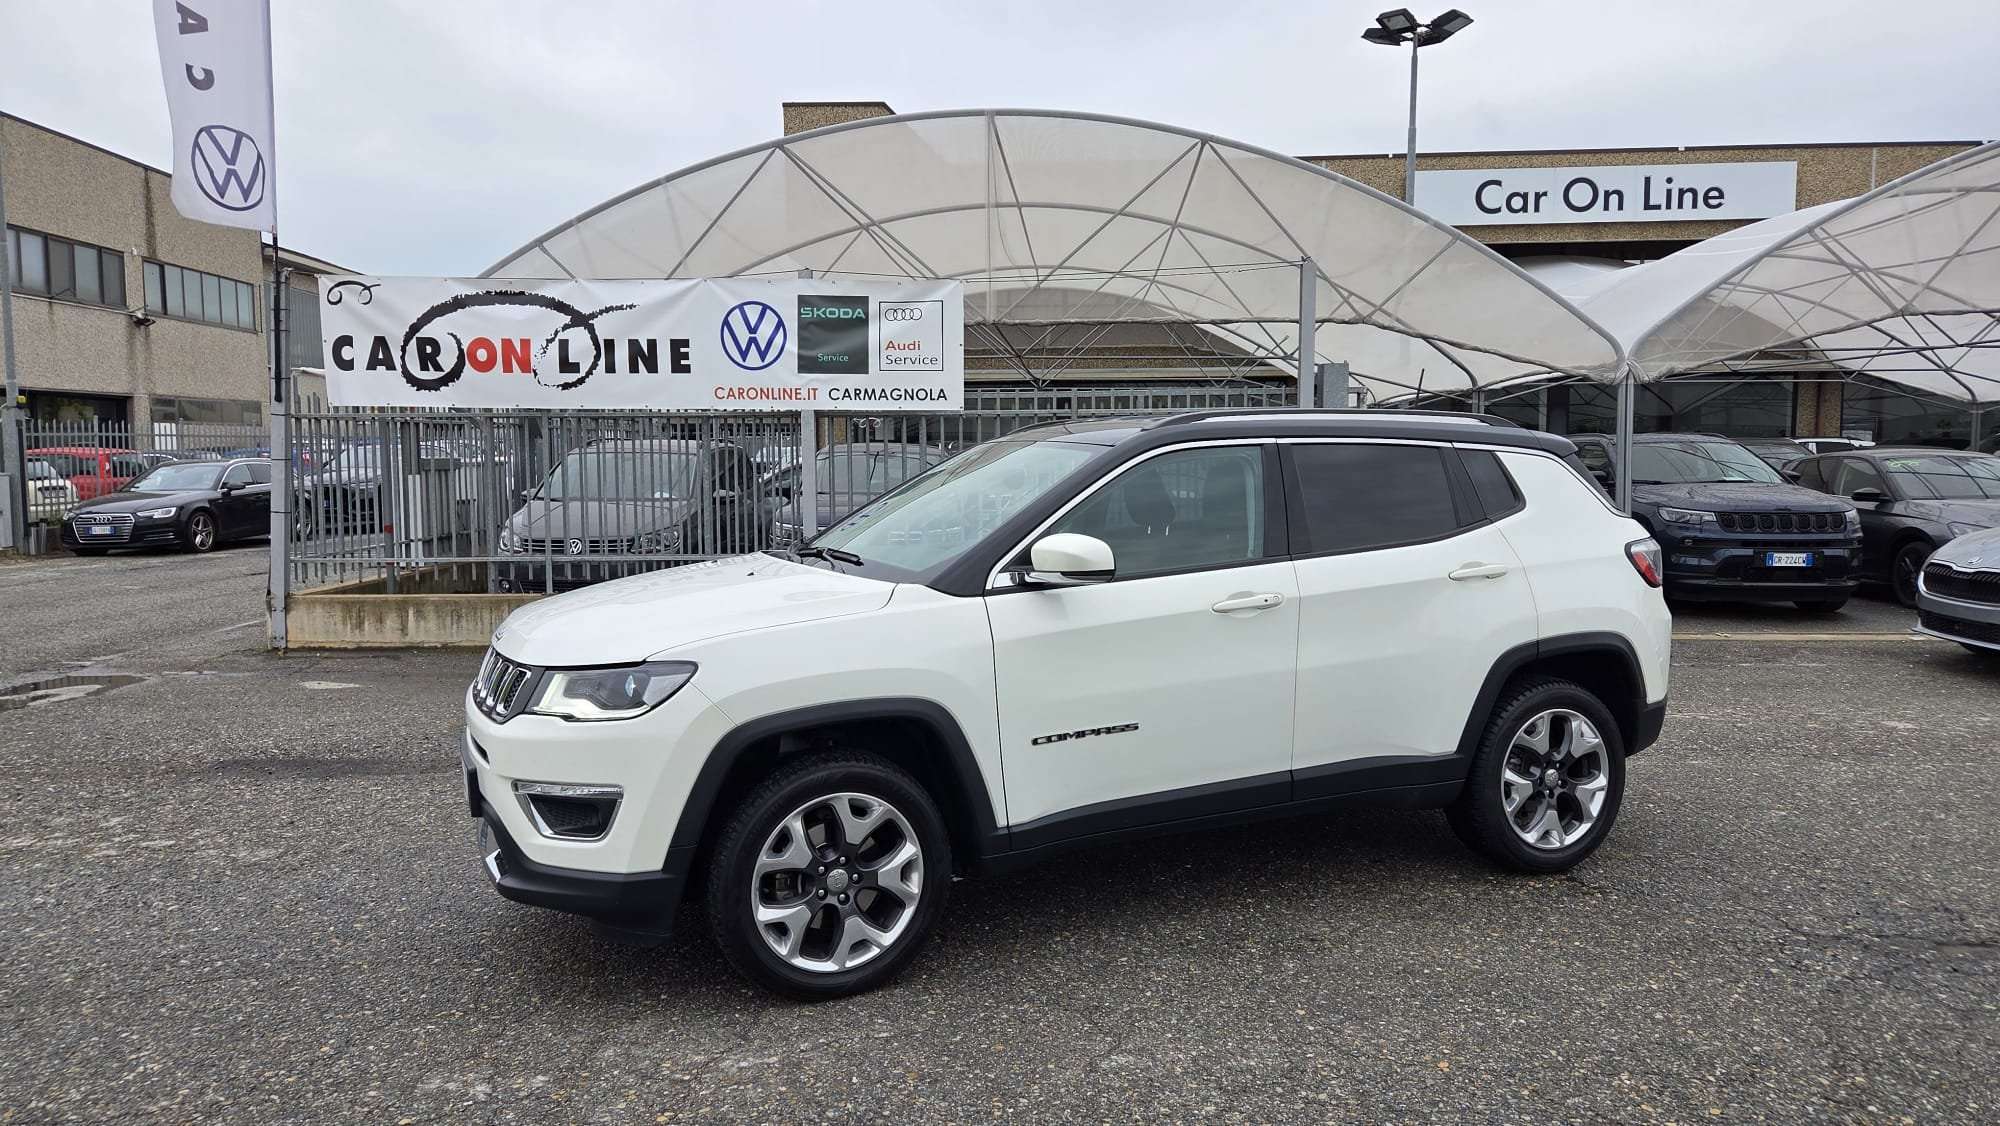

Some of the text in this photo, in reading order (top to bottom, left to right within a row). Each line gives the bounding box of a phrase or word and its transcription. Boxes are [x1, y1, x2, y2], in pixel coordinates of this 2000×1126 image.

[1475, 176, 1726, 214] Car On Line
[885, 340, 921, 351] Audi
[817, 352, 849, 362] Service
[885, 354, 938, 366] Service
[714, 386, 948, 401] CARONLINE.IT CARMAGNOLA
[1031, 723, 1139, 745] COMPASS
